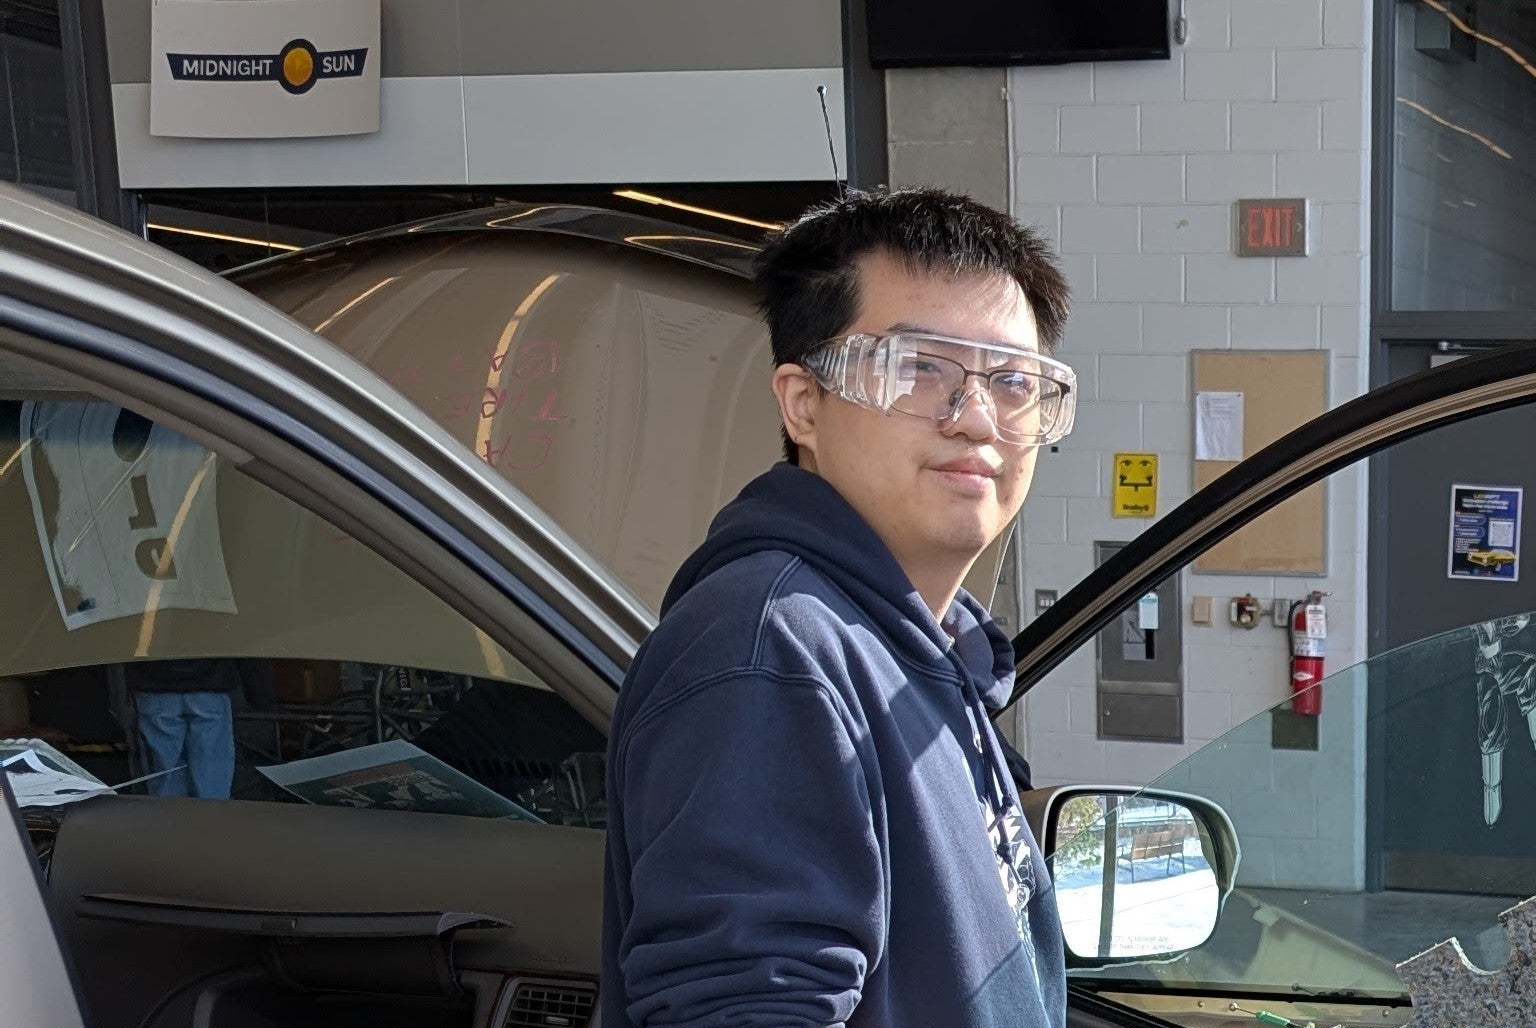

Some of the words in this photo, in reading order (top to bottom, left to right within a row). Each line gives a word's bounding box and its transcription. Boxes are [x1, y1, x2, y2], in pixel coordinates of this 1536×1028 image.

[182, 59, 274, 76] MIDNIGHT
[322, 54, 355, 73] SUN
[1247, 206, 1297, 248] EXIT
